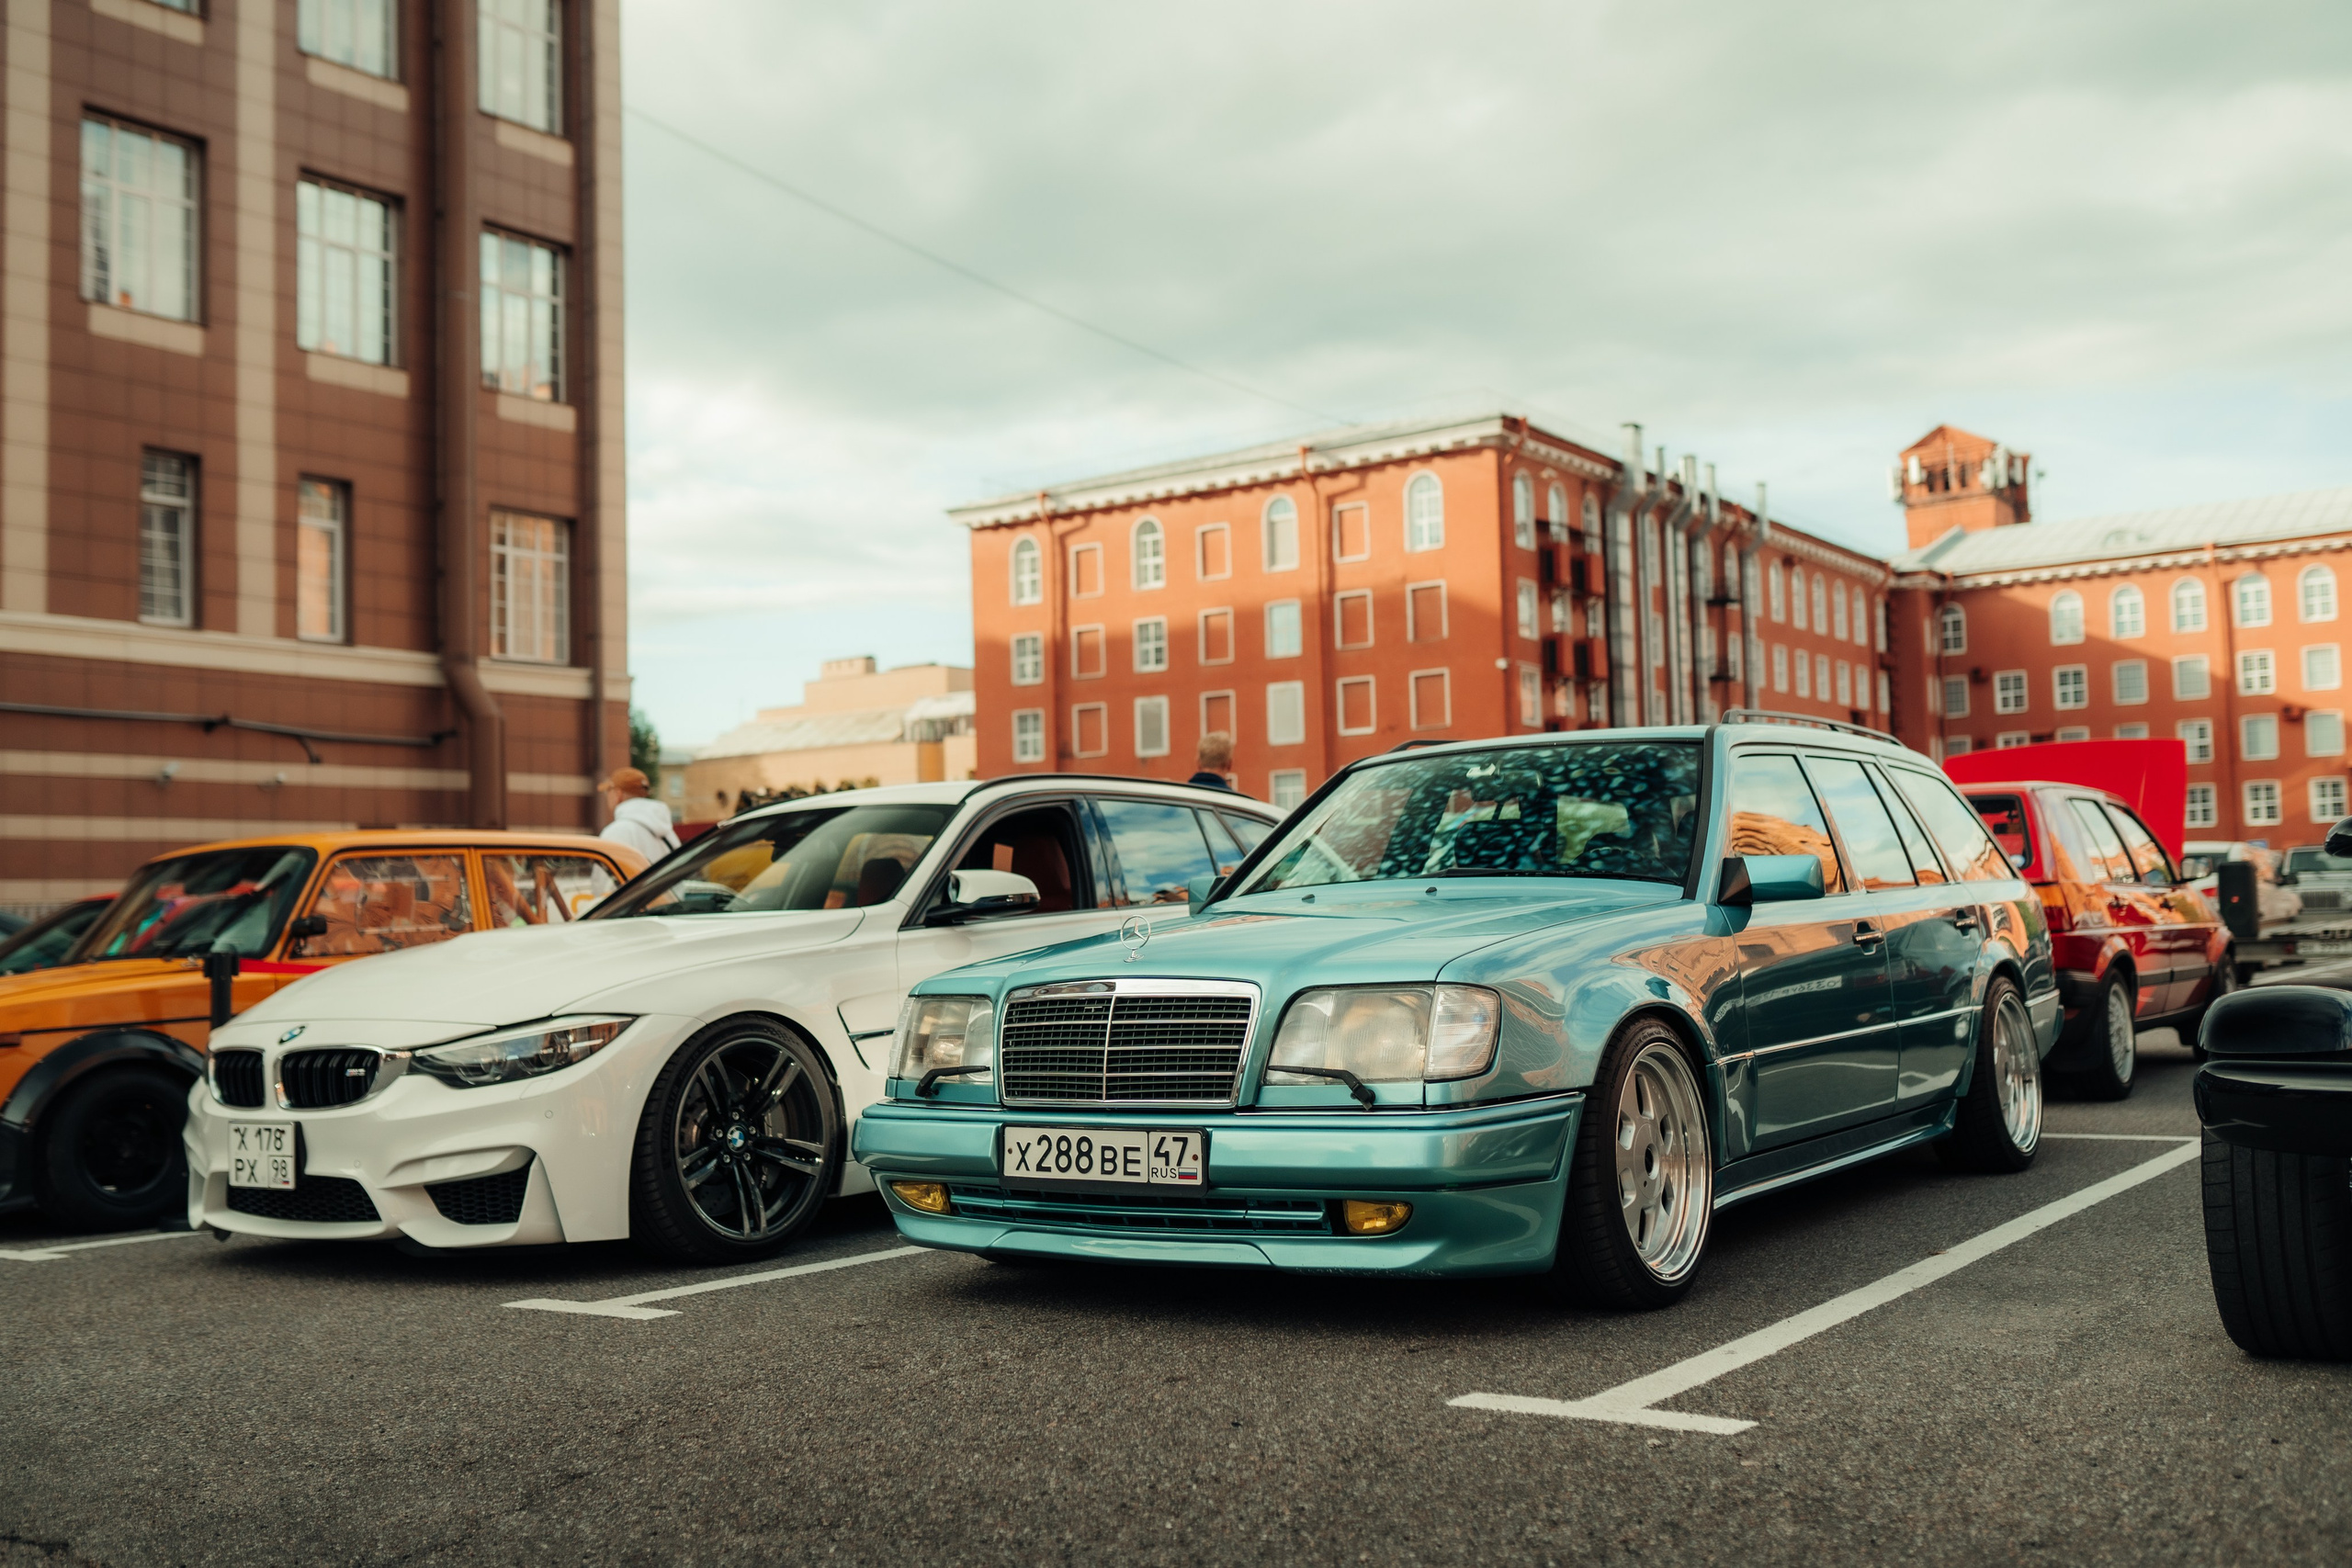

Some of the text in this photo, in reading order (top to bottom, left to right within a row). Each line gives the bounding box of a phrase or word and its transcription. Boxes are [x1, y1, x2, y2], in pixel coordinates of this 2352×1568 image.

[662, 1084, 679, 1149] MICHELIN
[1154, 1136, 1189, 1167] 47
[272, 1159, 288, 1178] 98
[1151, 1167, 1177, 1179] RUS
